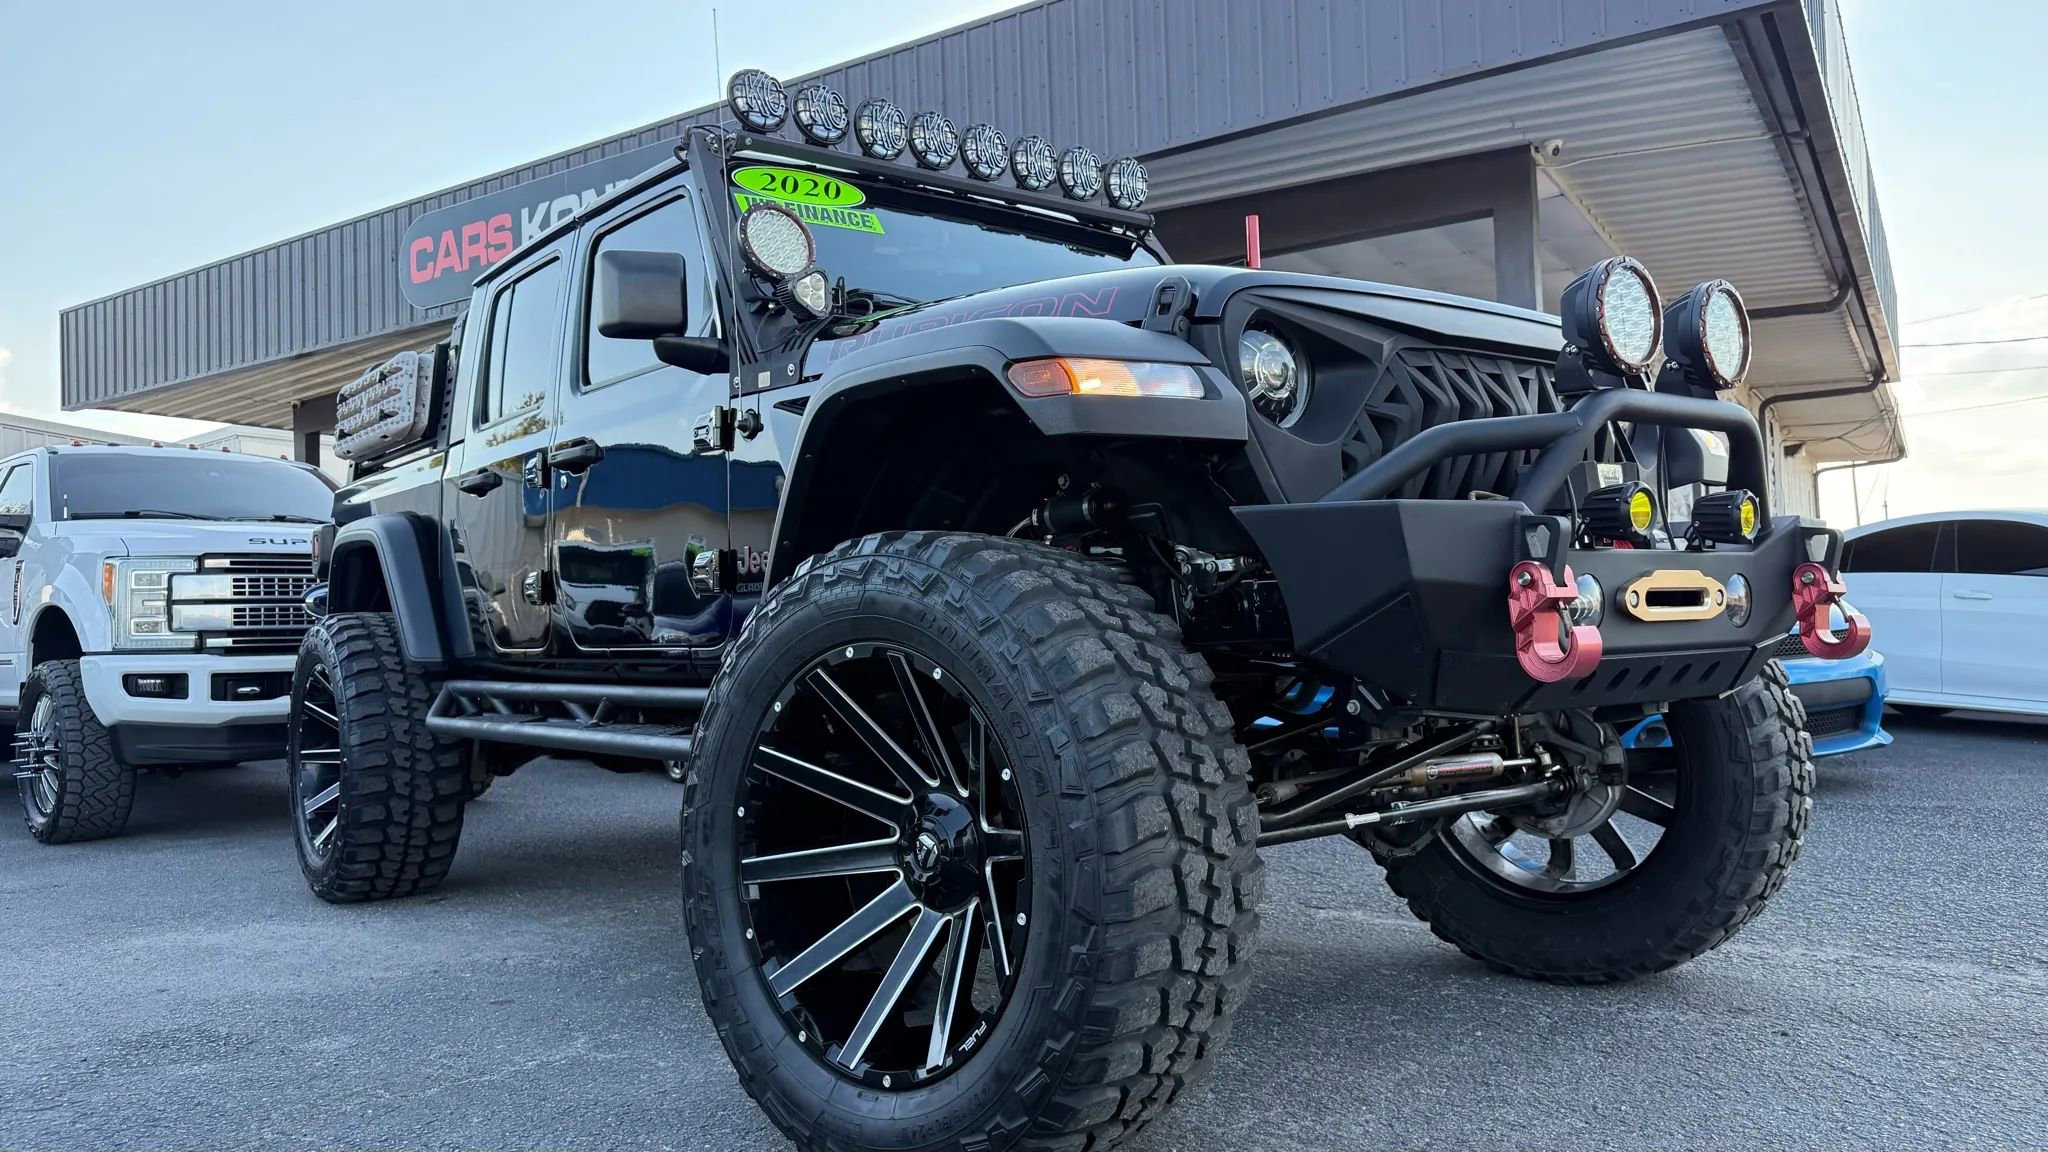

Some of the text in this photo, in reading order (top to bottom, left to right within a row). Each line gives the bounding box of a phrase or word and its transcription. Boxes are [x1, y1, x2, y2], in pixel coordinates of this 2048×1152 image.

[745, 71, 787, 117] KC
[808, 85, 848, 130] KC
[872, 103, 907, 150] KC
[923, 113, 958, 157] KC
[976, 125, 1008, 168] KC
[1027, 138, 1057, 182] KC
[1073, 148, 1102, 191] KC
[1119, 160, 1148, 202] KC
[760, 172, 842, 200] 2020
[410, 180, 632, 284] CARS KO
[784, 202, 873, 229] FINANCE
[249, 537, 311, 545] SUP
[737, 545, 770, 574] Jee
[736, 583, 764, 592] GLADI
[958, 1020, 988, 1052] FUEL
